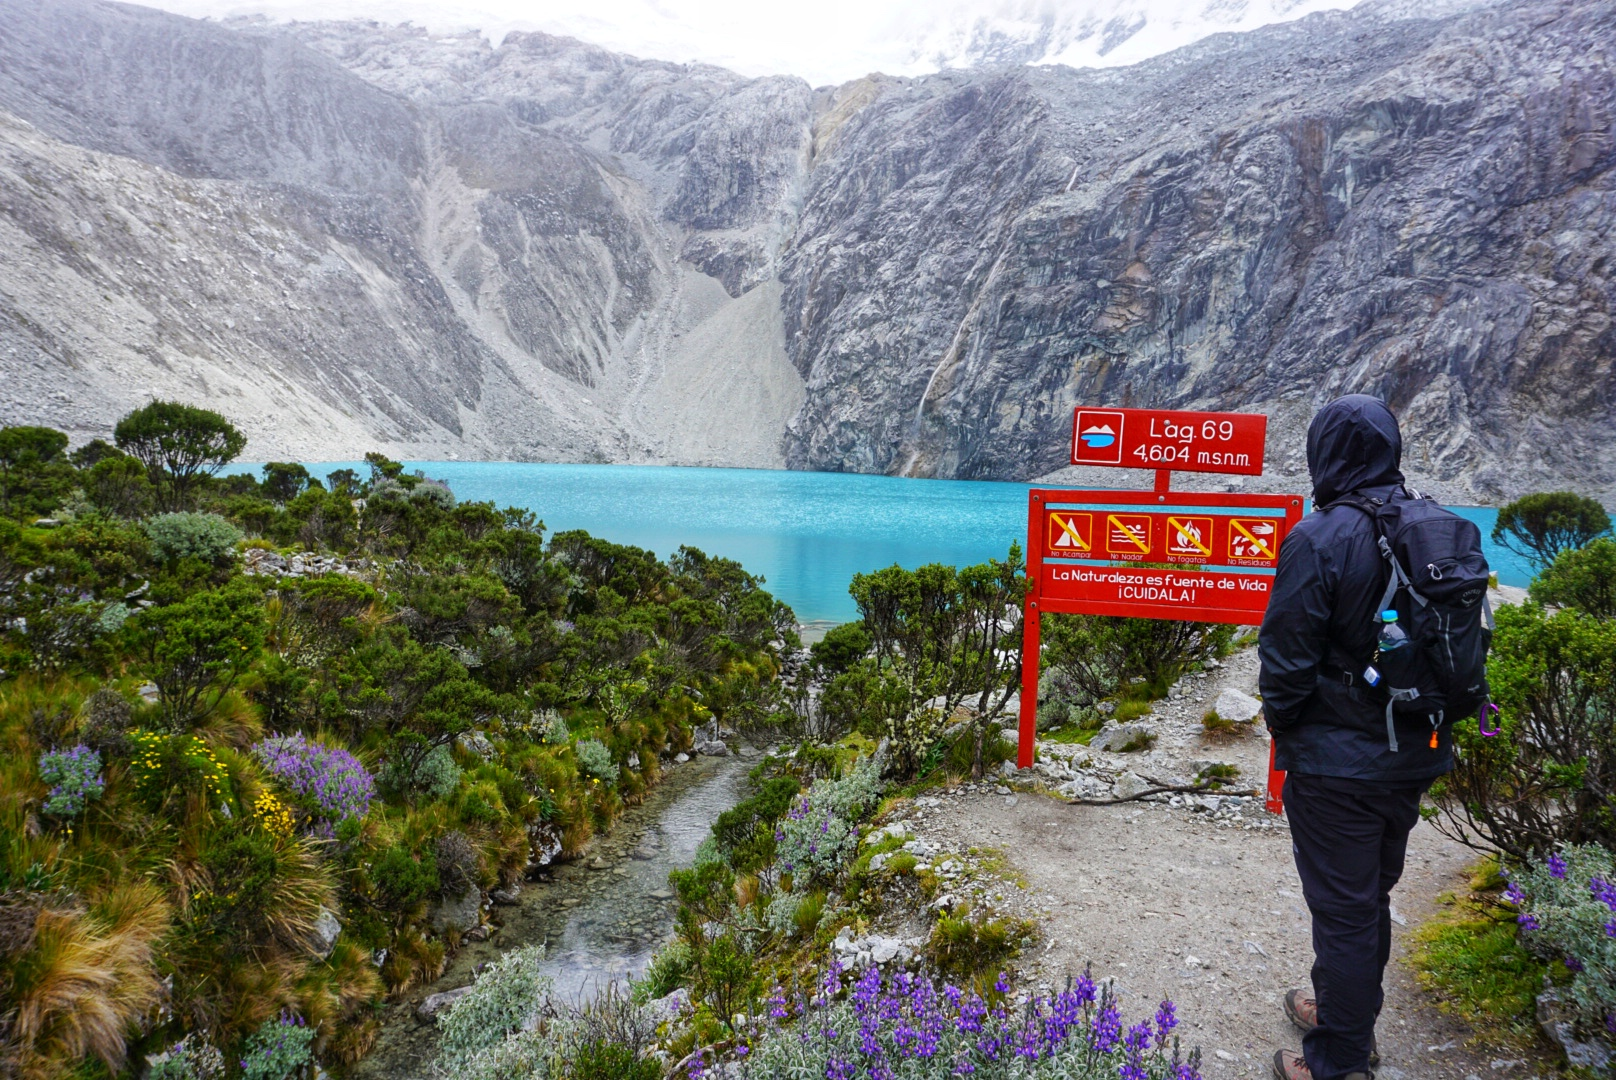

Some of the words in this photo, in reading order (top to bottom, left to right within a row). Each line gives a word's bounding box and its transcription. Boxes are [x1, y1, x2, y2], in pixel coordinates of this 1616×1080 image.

[1150, 418, 1197, 444] Lag.
[1202, 420, 1233, 441] 69
[1133, 444, 1189, 463] 4,604
[1197, 451, 1251, 467] m.s.n.m.
[1062, 551, 1091, 559] Acampar
[1121, 553, 1143, 561] Nadar
[1178, 555, 1207, 564] fogatas
[1238, 558, 1271, 567] Residuos
[1052, 569, 1069, 580] La
[1071, 570, 1143, 584] Naturaleza
[1145, 576, 1162, 586] es
[1165, 575, 1214, 589] fuente
[1217, 577, 1235, 590] de
[1238, 578, 1267, 592] Vida
[1118, 585, 1196, 603] ¡CUIDALA!
